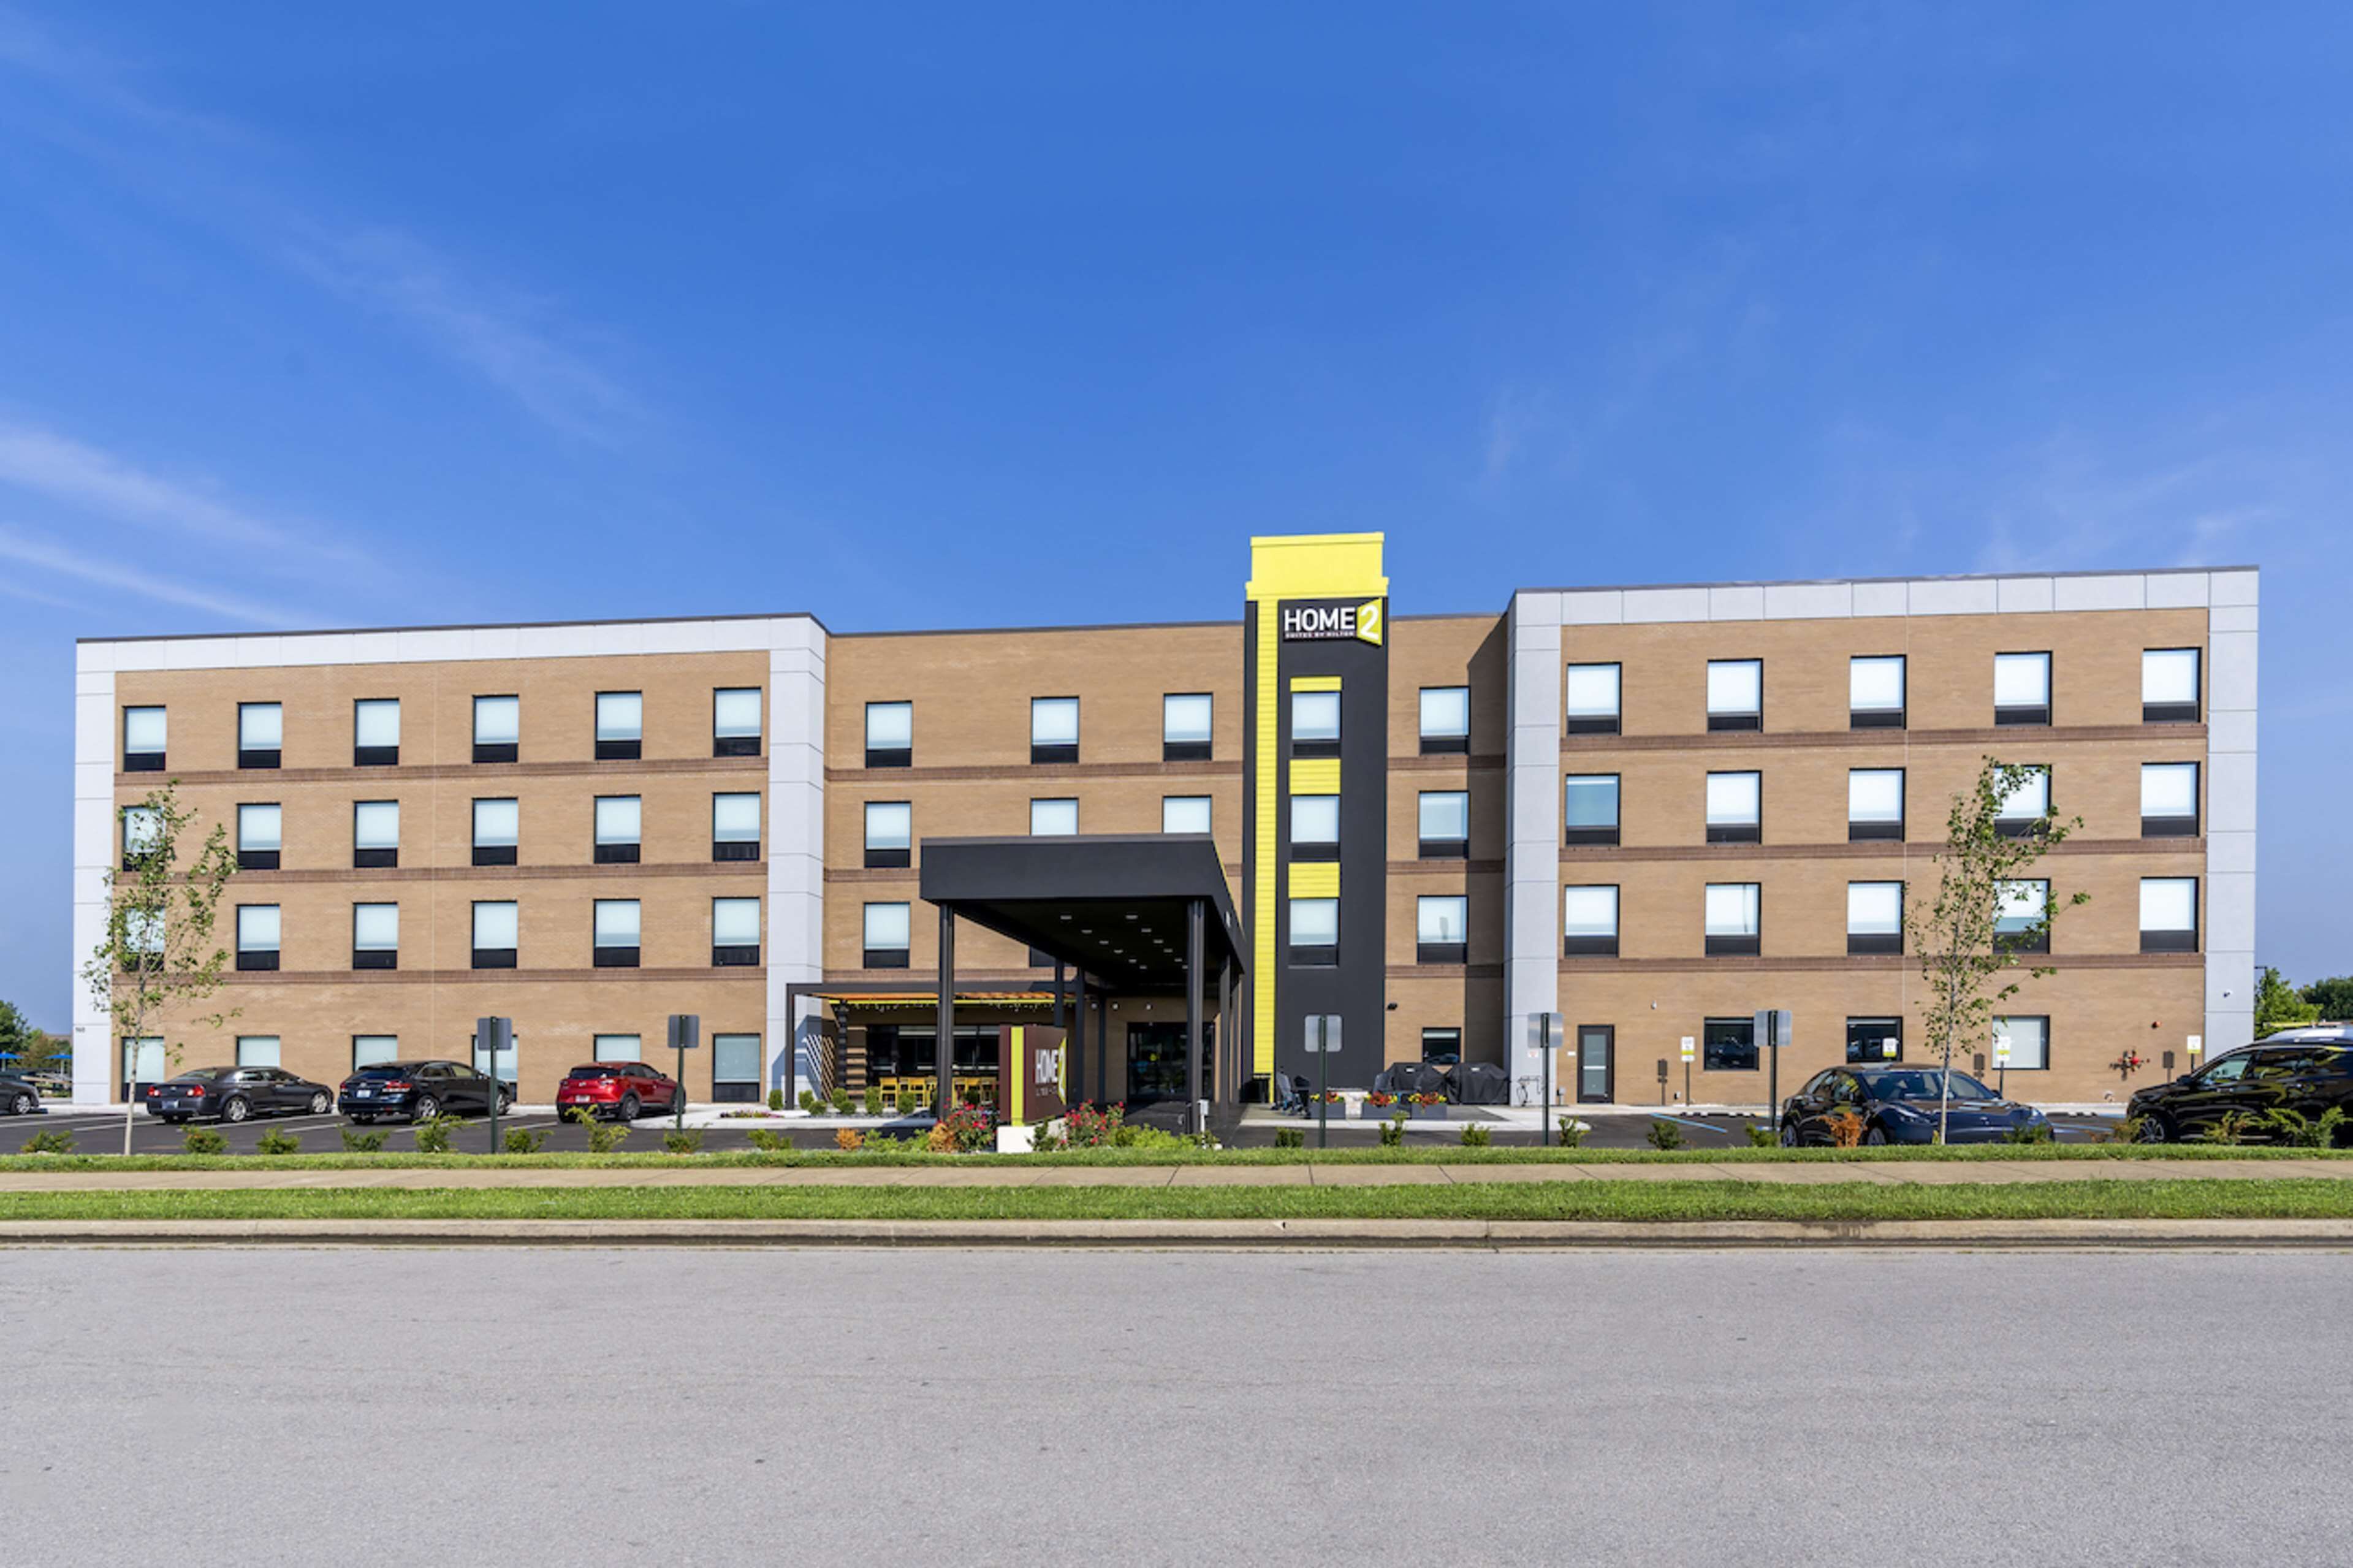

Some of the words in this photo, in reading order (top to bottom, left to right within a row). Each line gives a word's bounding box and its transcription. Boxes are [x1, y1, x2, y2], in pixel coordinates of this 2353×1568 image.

[1285, 607, 1355, 631] HOME
[1360, 604, 1379, 641] 2
[1035, 1049, 1059, 1084] HOME
